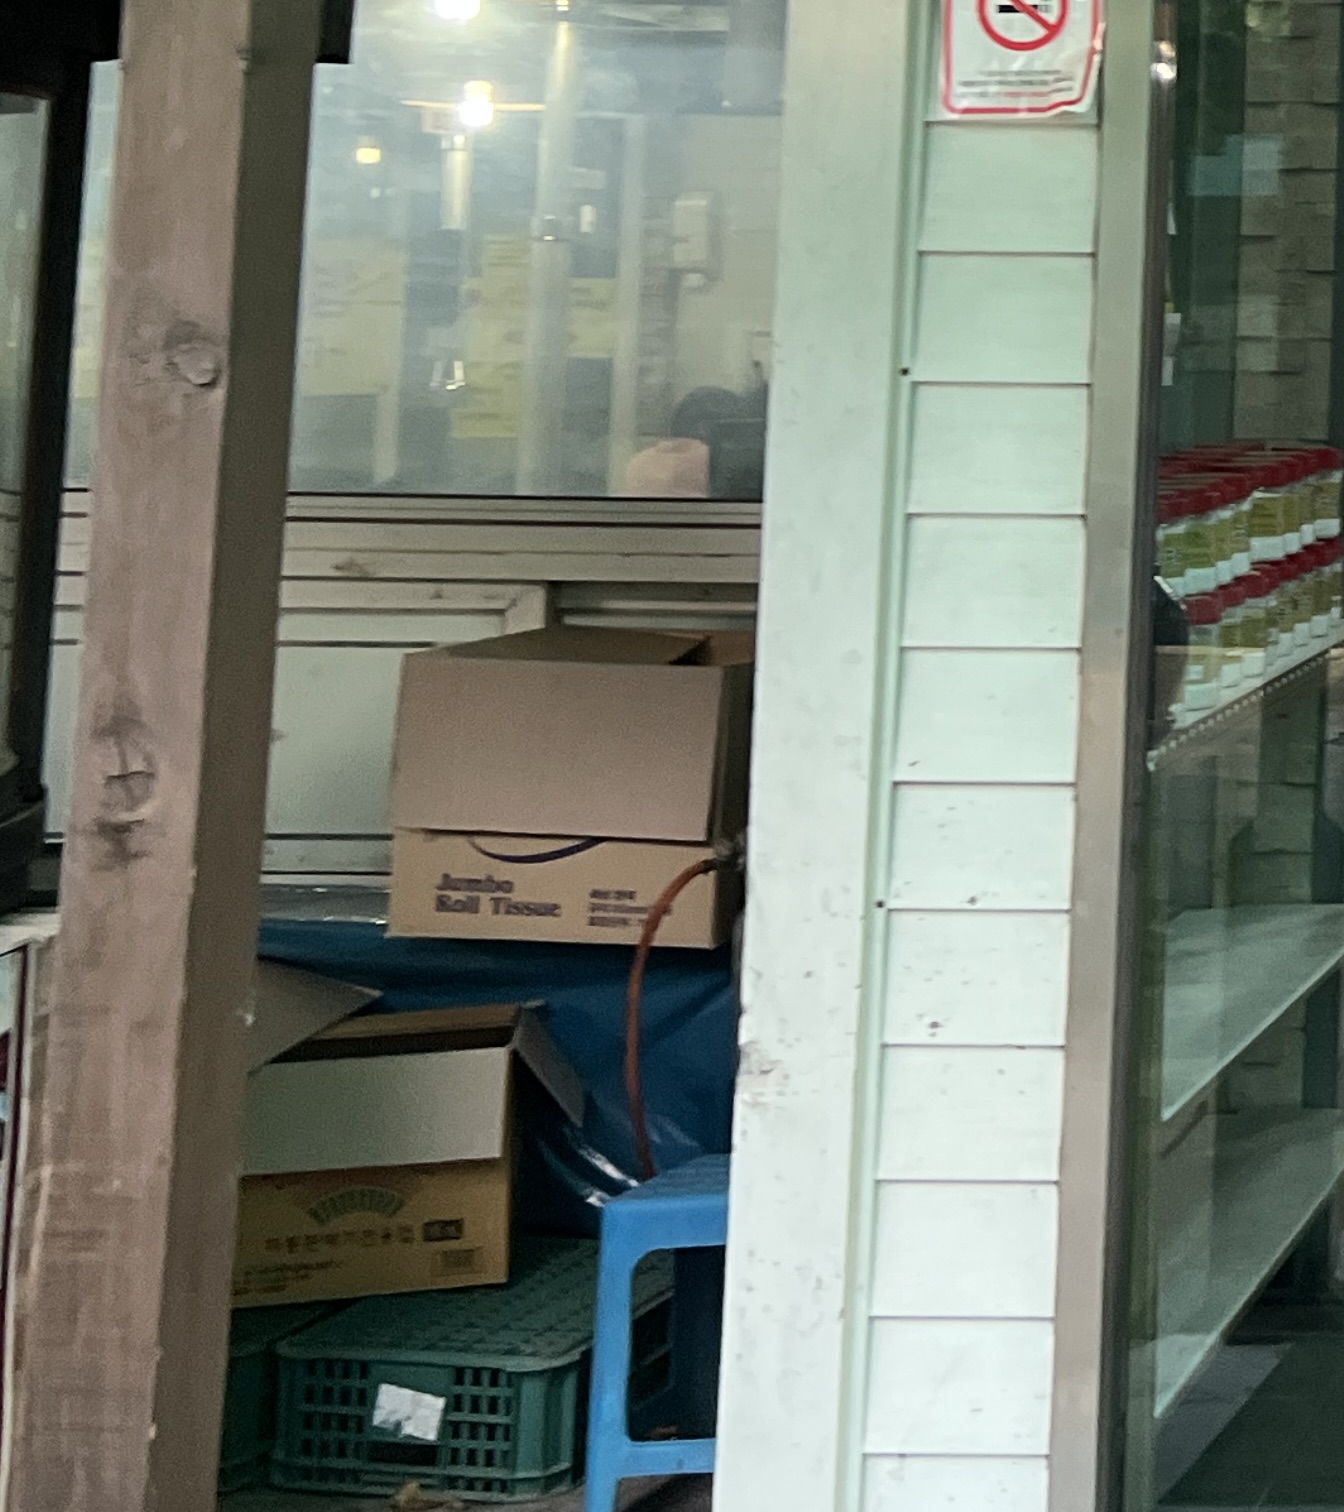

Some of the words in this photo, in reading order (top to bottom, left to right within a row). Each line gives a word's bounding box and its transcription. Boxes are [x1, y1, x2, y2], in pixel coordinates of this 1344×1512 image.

[436, 873, 514, 894] Jumbo
[436, 894, 481, 914] Roll
[489, 896, 562, 918] Tissue
